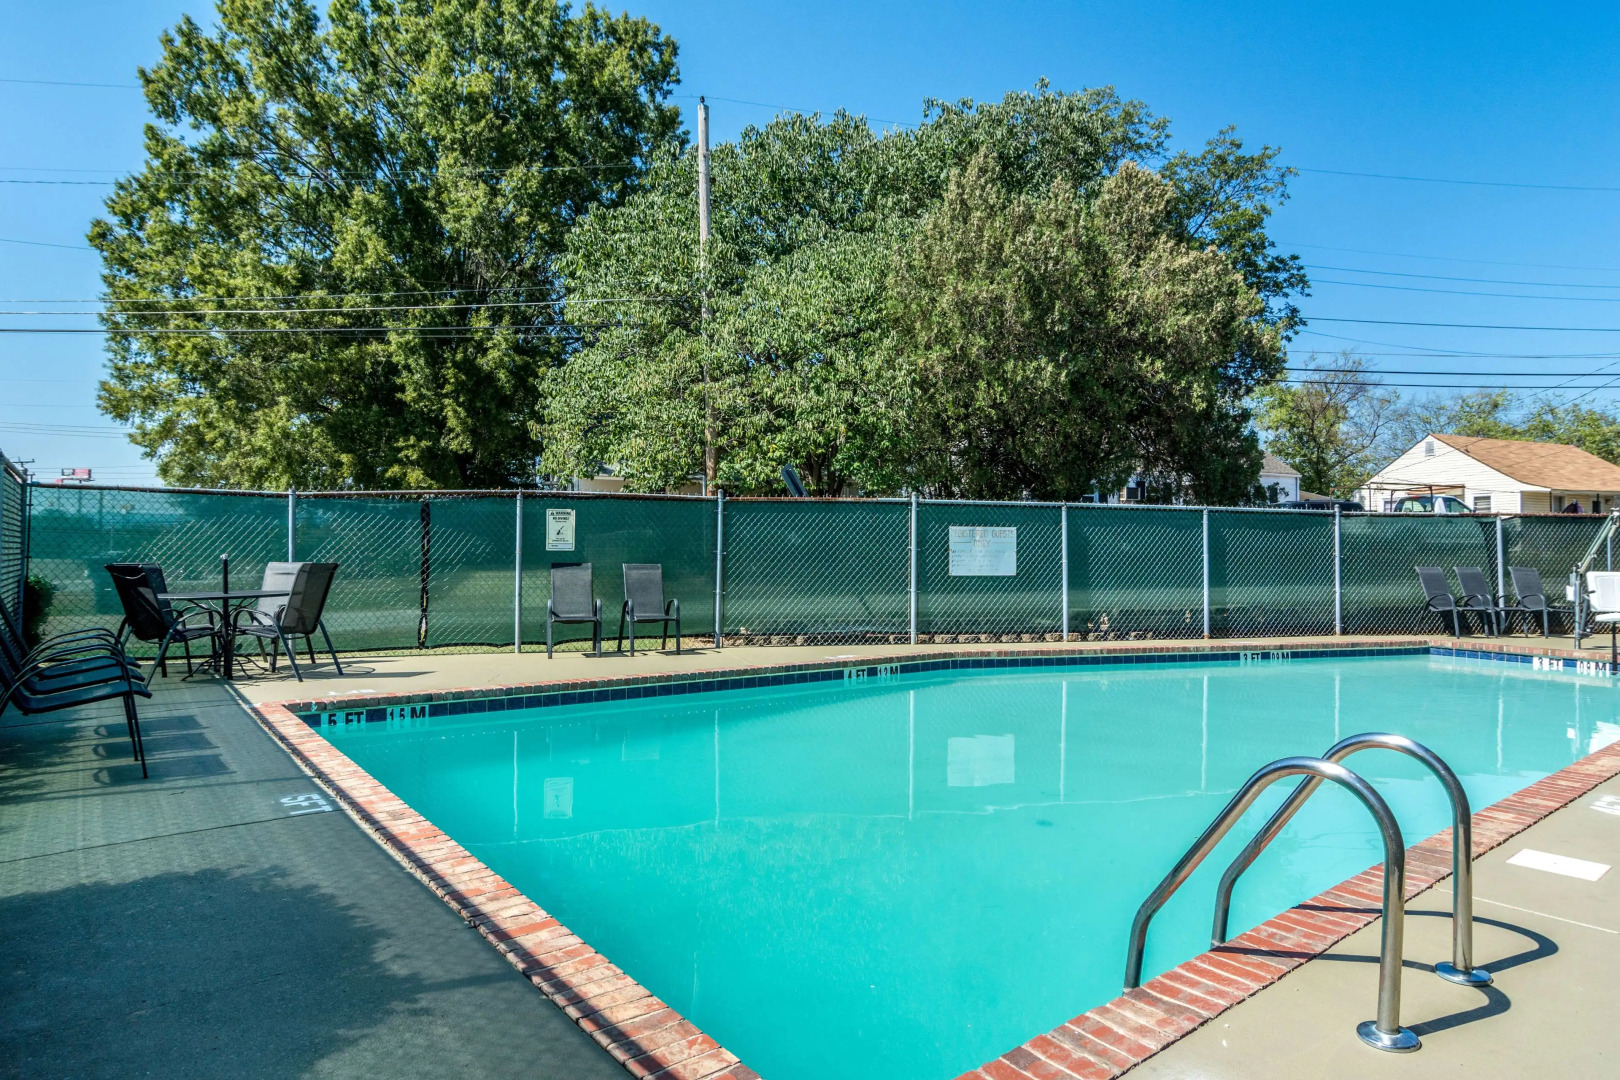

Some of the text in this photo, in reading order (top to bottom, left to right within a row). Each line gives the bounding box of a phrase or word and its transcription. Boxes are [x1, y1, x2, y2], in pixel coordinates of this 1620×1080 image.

[951, 529, 1014, 538] EGISTERED GUESTS
[974, 538, 991, 548] ONLY
[1251, 652, 1260, 660] FT
[1548, 658, 1562, 666] FT
[856, 668, 866, 678] FT
[328, 712, 337, 726] 5
[344, 711, 364, 725] FT
